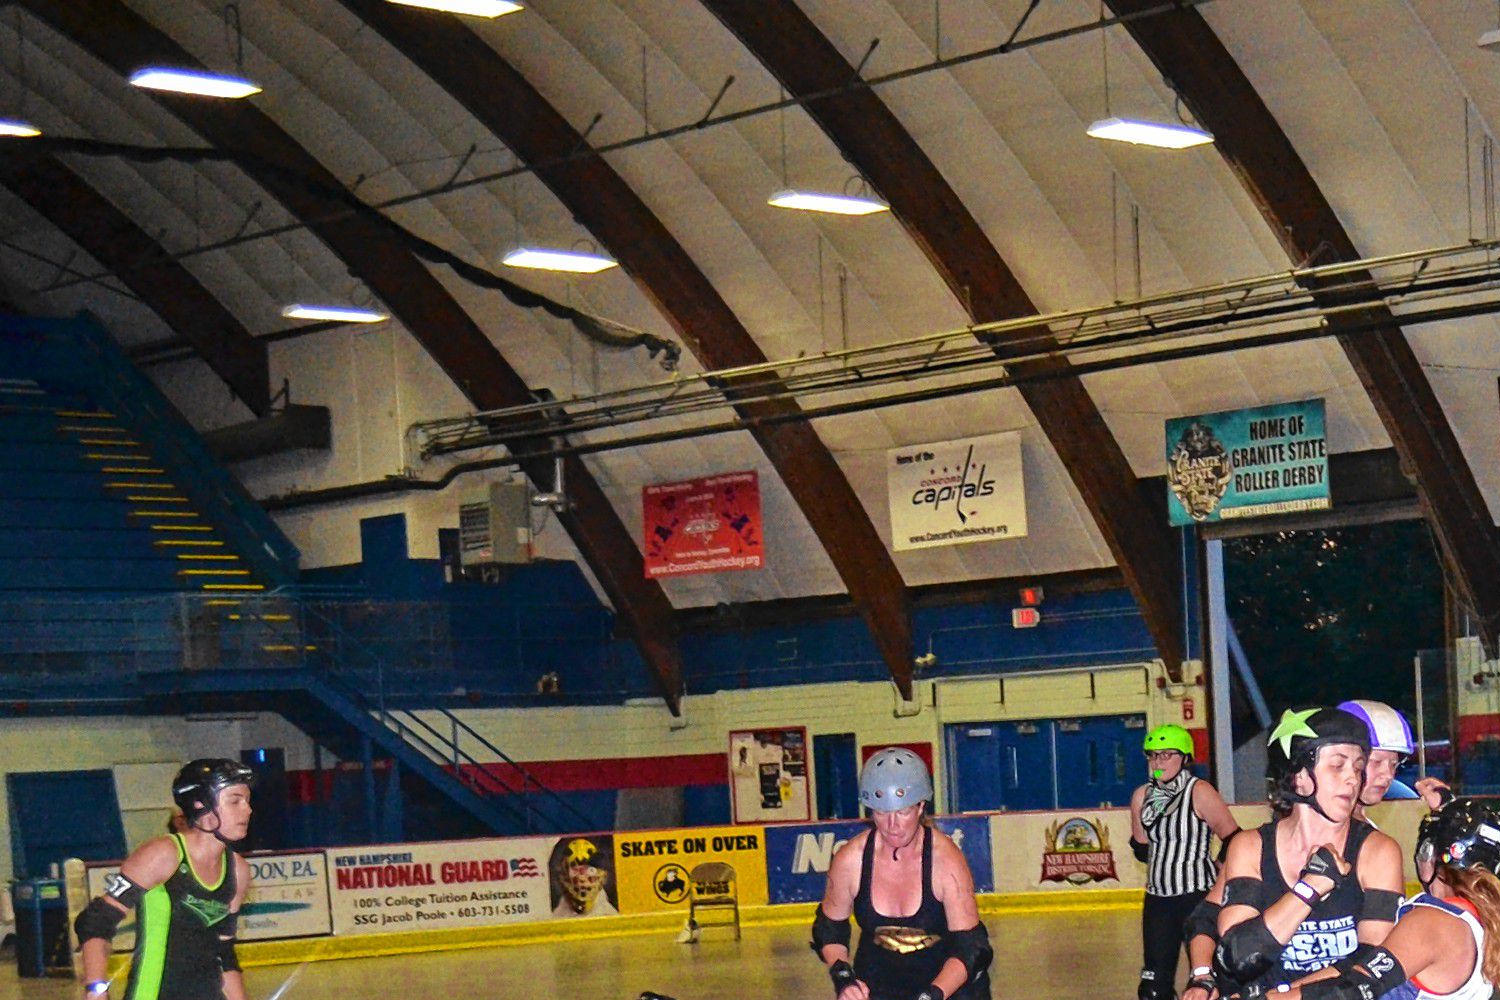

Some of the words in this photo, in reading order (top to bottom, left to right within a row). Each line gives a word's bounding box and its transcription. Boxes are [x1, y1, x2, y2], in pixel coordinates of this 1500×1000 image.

[1250, 418, 1286, 441] HOME
[1288, 415, 1304, 436] OF
[1232, 444, 1286, 468] GRANITE
[1288, 439, 1326, 461] STATE
[912, 444, 995, 524] capitals
[1235, 469, 1280, 493] ROLLER
[1283, 465, 1324, 487] DERBY
[335, 855, 357, 866] NEW
[359, 852, 413, 866] HAMPSHIRE
[620, 838, 678, 858] SKATE
[683, 837, 706, 853] ON
[712, 835, 758, 852] OVER
[336, 863, 435, 890] NATIONAL
[441, 859, 509, 884] GUARD
[353, 897, 381, 908] 100%
[385, 894, 428, 908] College
[429, 892, 468, 904] Tuition
[470, 890, 528, 902] Assistance
[353, 914, 378, 926] SSG
[382, 912, 413, 925] Jacob
[416, 910, 447, 921] Poole
[1319, 915, 1354, 931] STATE
[1367, 952, 1395, 979] 12
